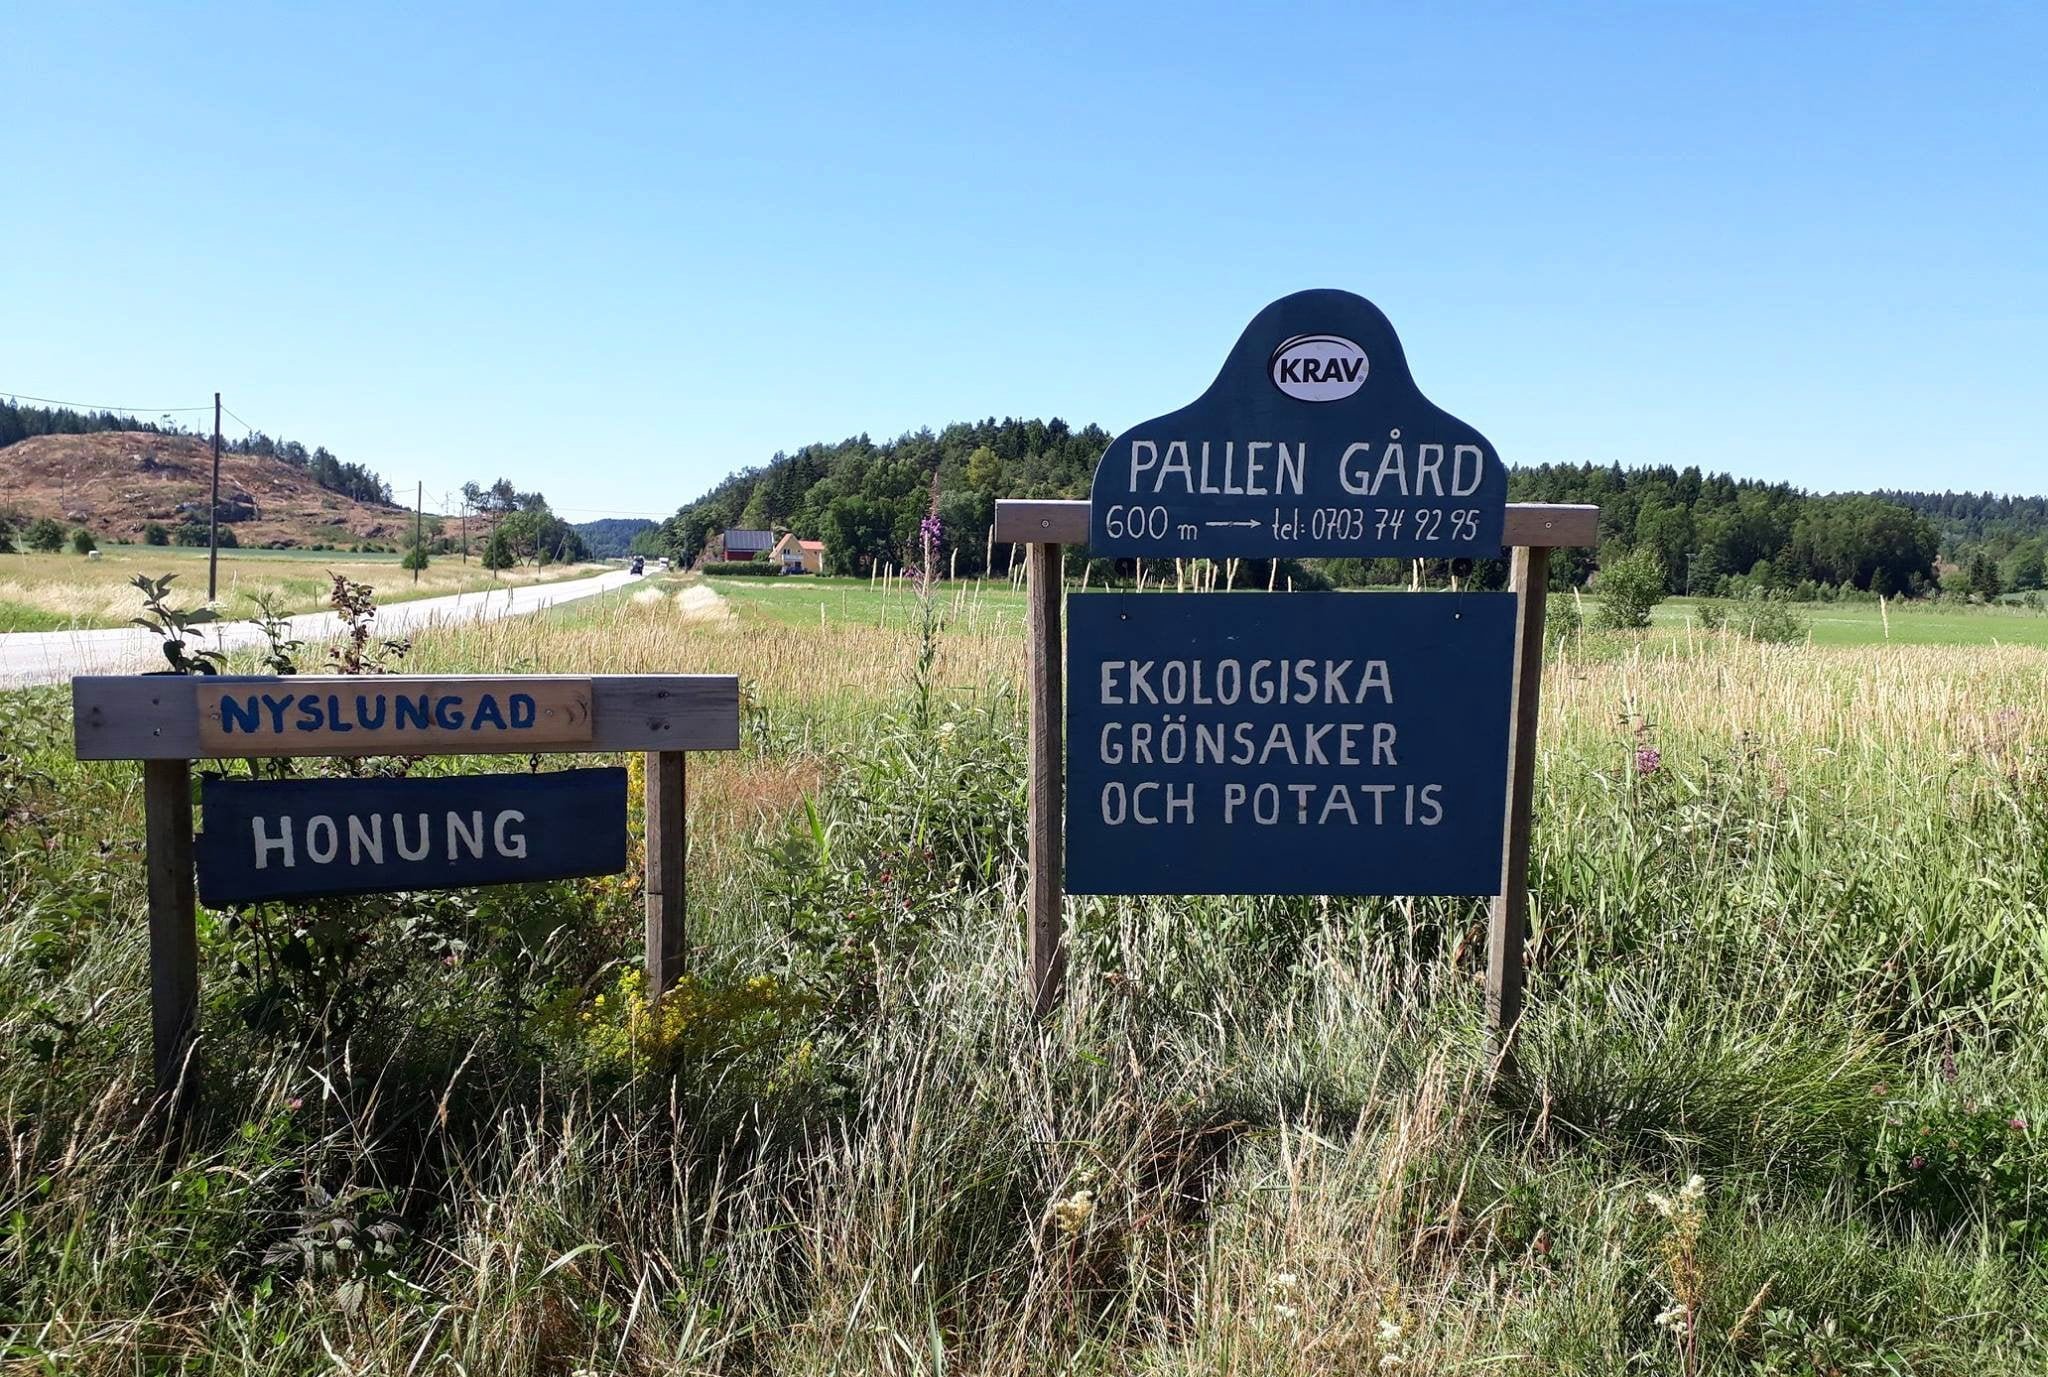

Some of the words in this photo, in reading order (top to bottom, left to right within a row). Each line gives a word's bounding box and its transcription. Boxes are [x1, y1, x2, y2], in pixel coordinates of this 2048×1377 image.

[1279, 357, 1364, 384] KRAV
[1129, 440, 1307, 496] PALLEN
[1339, 428, 1484, 497] GÅRD
[1105, 504, 1169, 541] 600
[1177, 523, 1199, 541] m
[1272, 507, 1306, 541] tel:
[1312, 508, 1364, 541] 0703
[1373, 508, 1405, 541] 74
[1414, 509, 1443, 541] 92
[1450, 509, 1480, 541] 95
[1100, 659, 1394, 705] EKOLOGISKA
[219, 692, 537, 735] NYSLUNGAD
[1100, 713, 1398, 766] GRÖNSAKER
[1101, 781, 1195, 826] OCH
[1224, 782, 1443, 826] POTATIS
[251, 808, 527, 870] HONUNG
